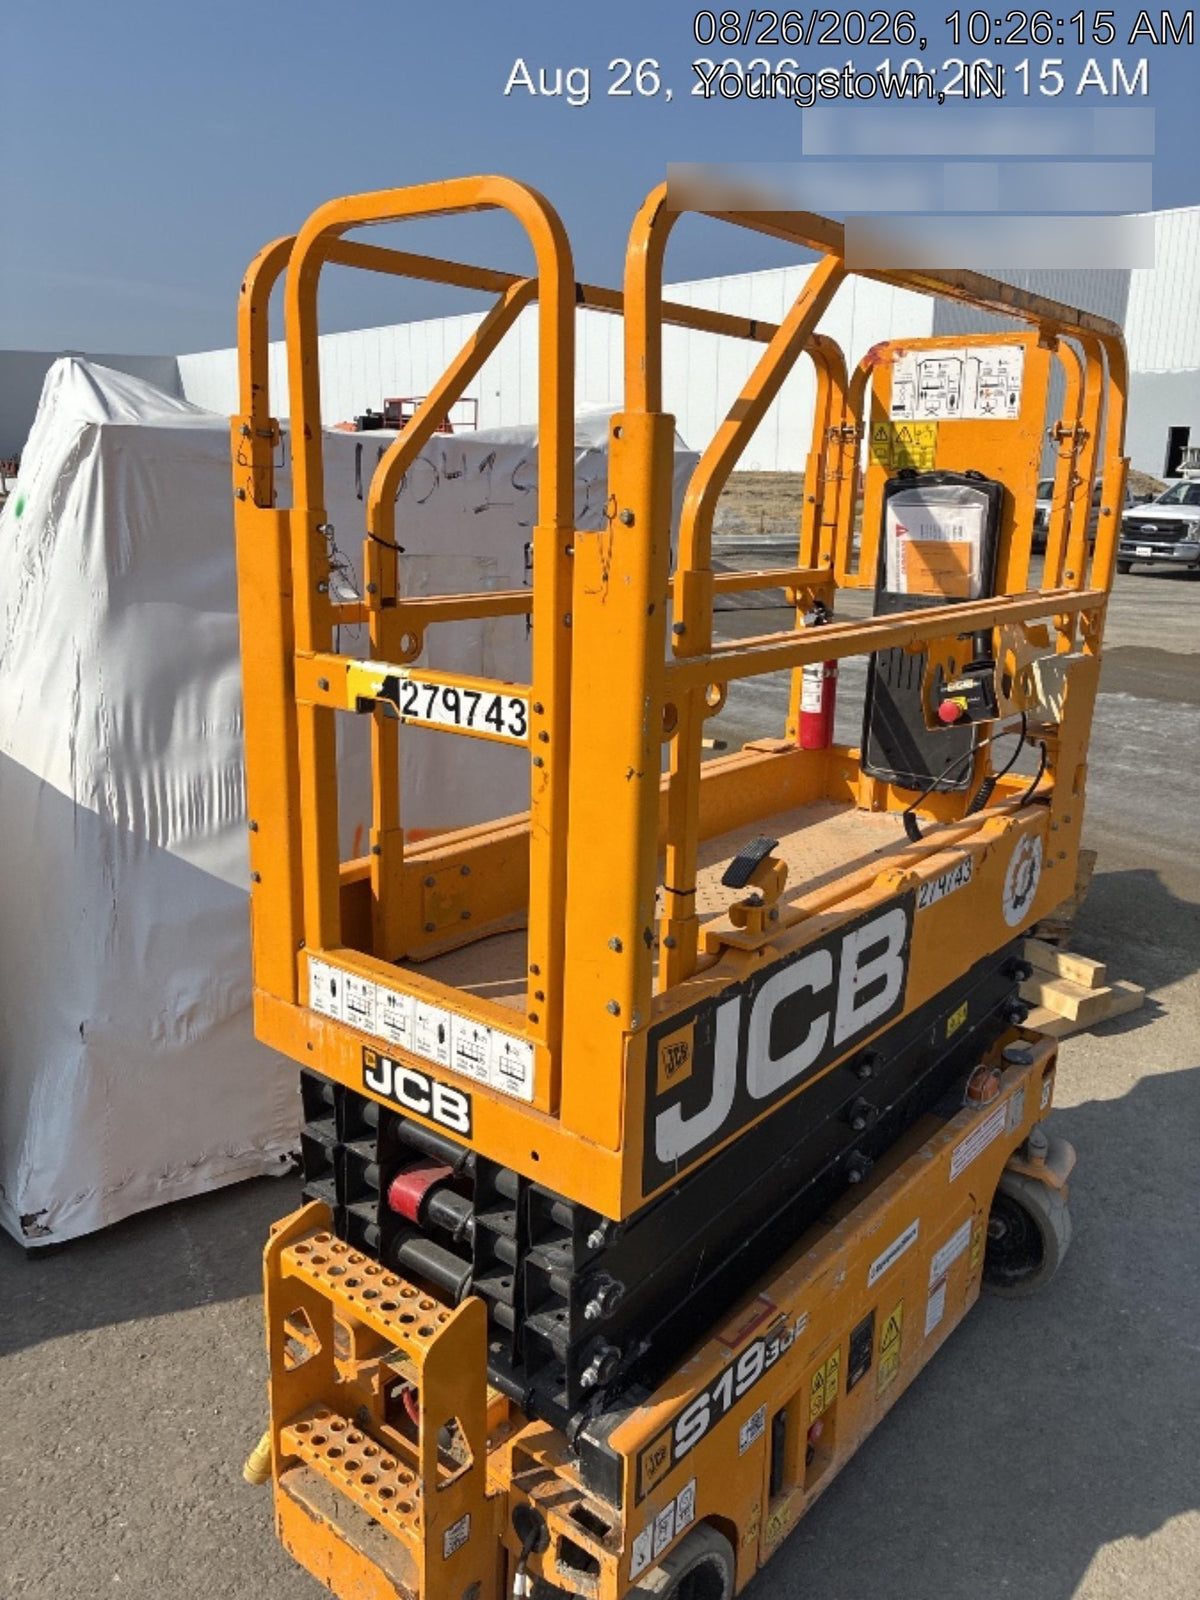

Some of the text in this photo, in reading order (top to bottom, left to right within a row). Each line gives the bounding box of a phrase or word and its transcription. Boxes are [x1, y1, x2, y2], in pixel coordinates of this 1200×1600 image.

[401, 680, 528, 737] 279743
[655, 907, 908, 1164] JCB
[365, 1058, 470, 1135] JCB
